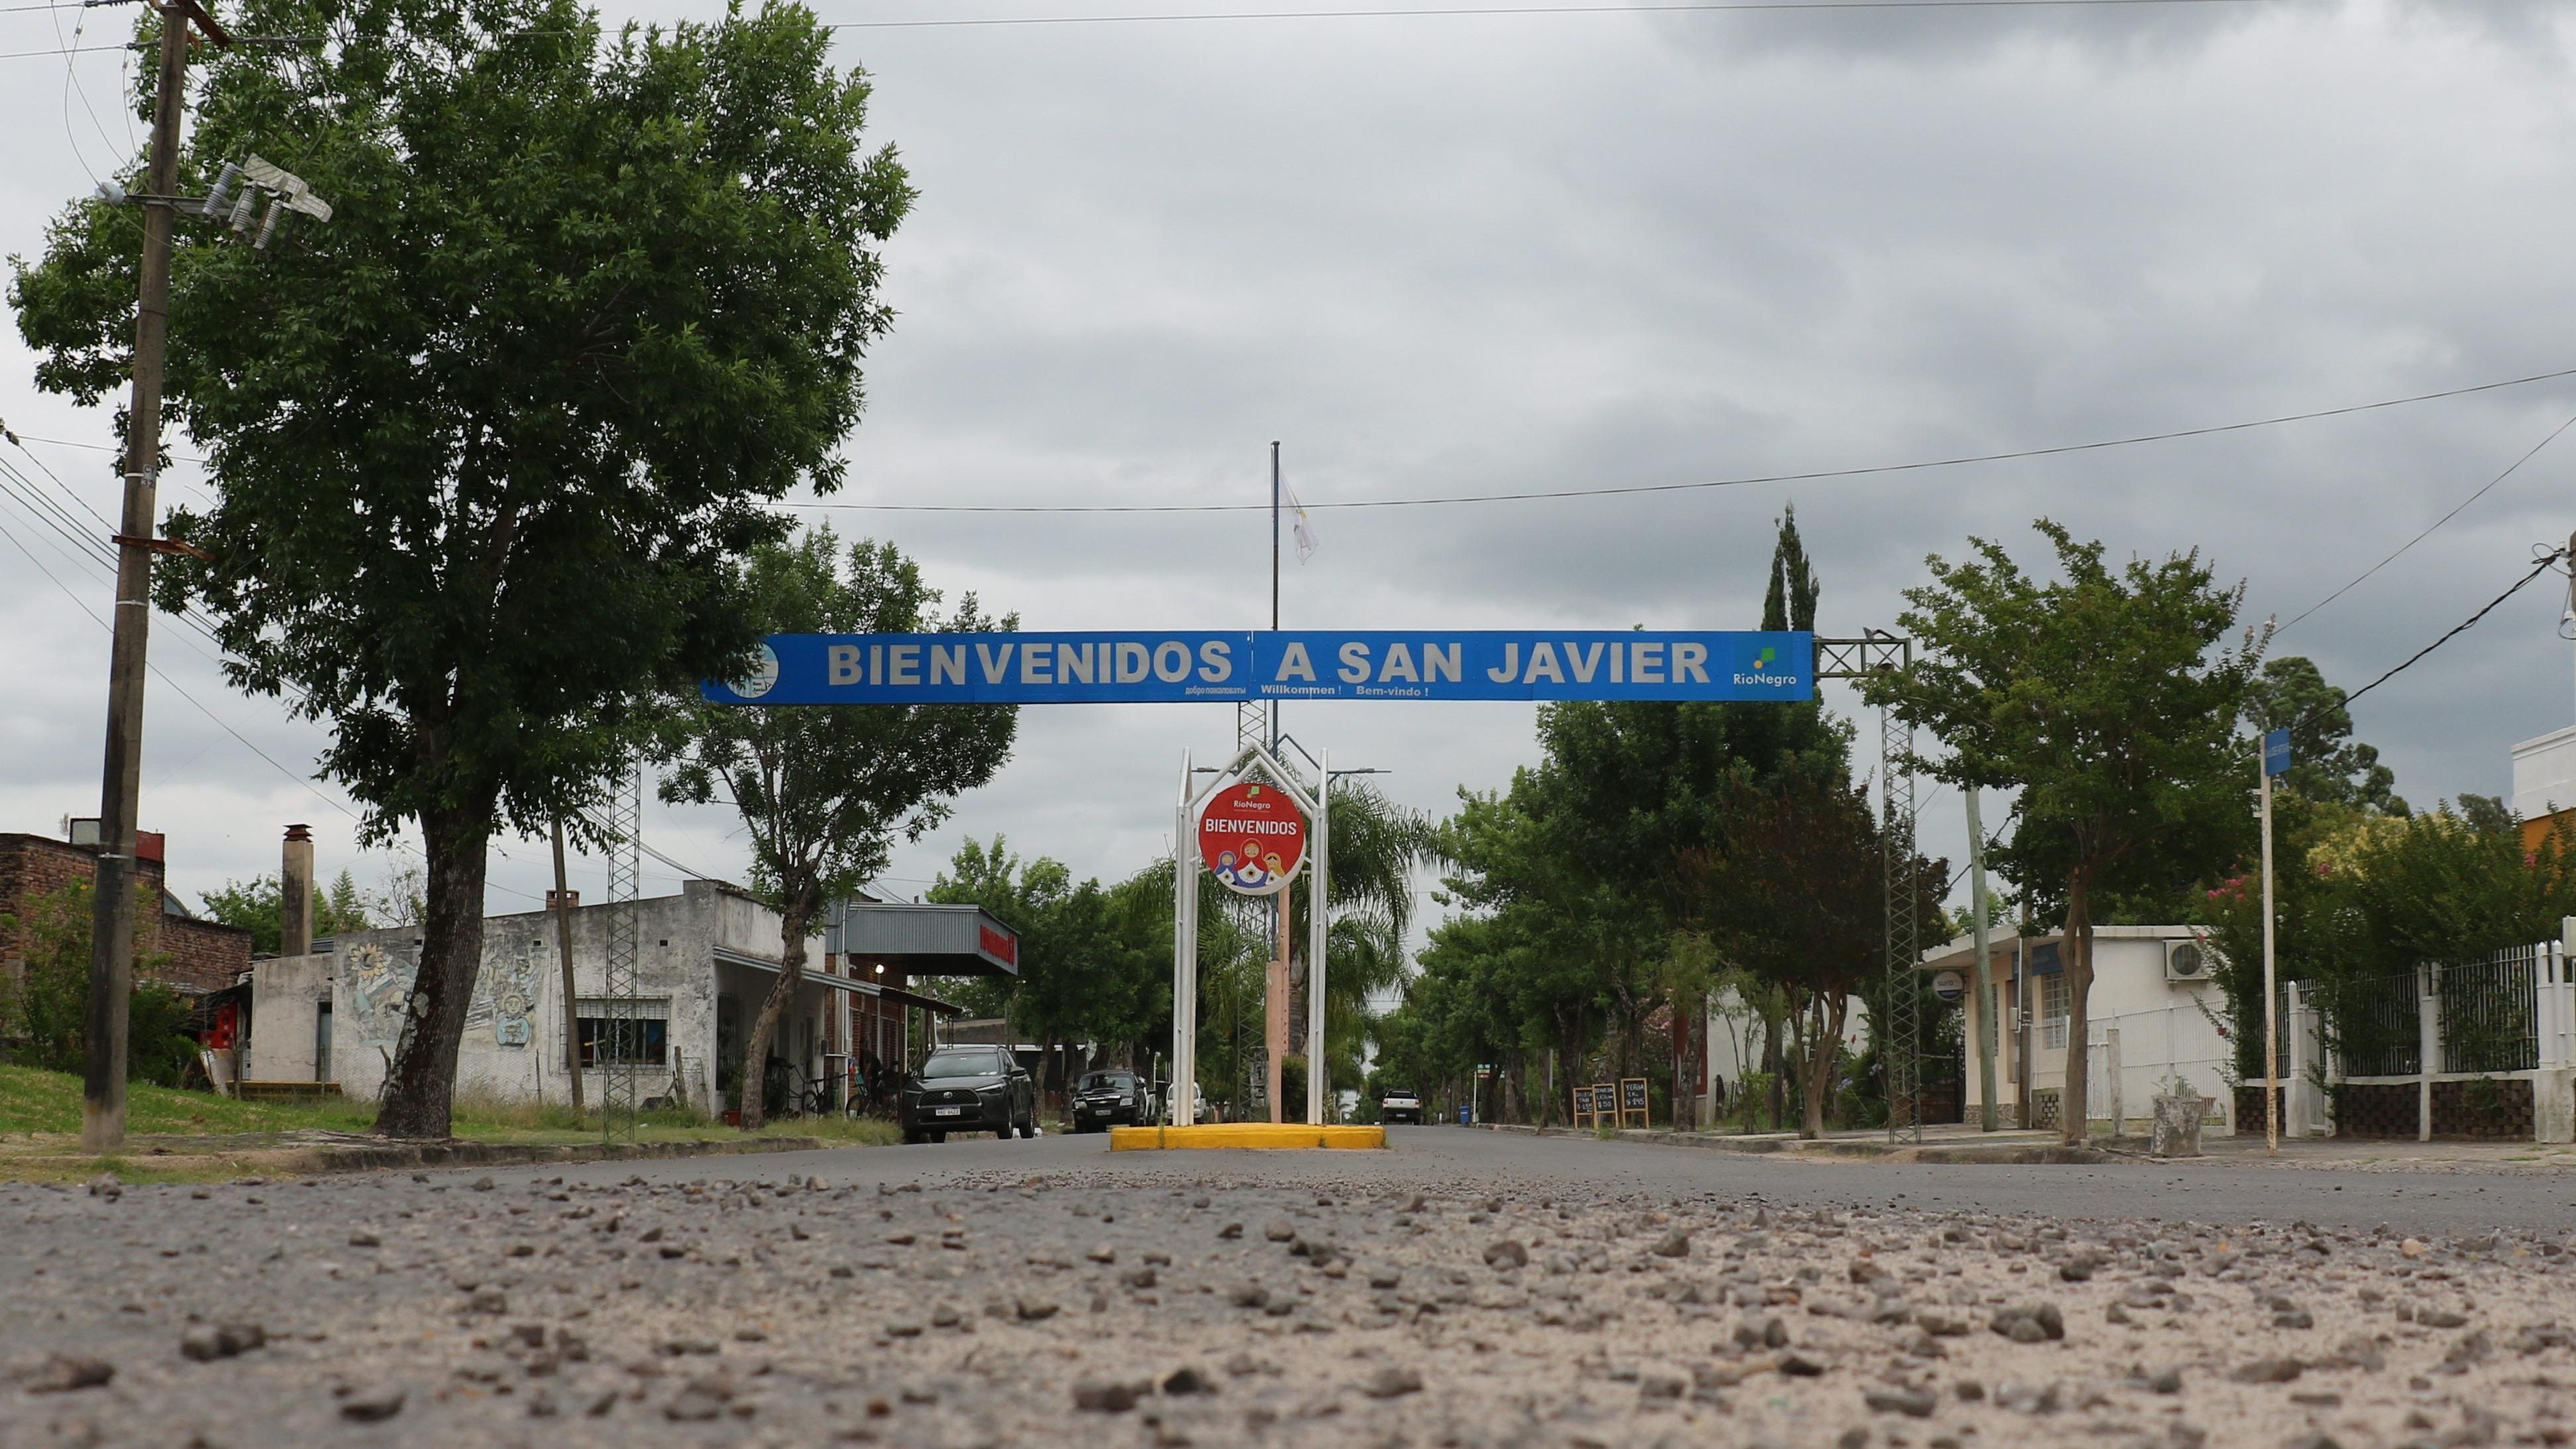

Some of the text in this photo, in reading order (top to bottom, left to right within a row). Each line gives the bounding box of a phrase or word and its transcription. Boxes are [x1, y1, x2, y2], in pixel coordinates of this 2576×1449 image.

[828, 640, 1711, 686] BIENVENIDOS A SAN JAVIER
[1261, 684, 1335, 694] Willkommen
[1356, 686, 1421, 696] Bem-vindo
[1205, 818, 1297, 835] BIENVENIDOS
